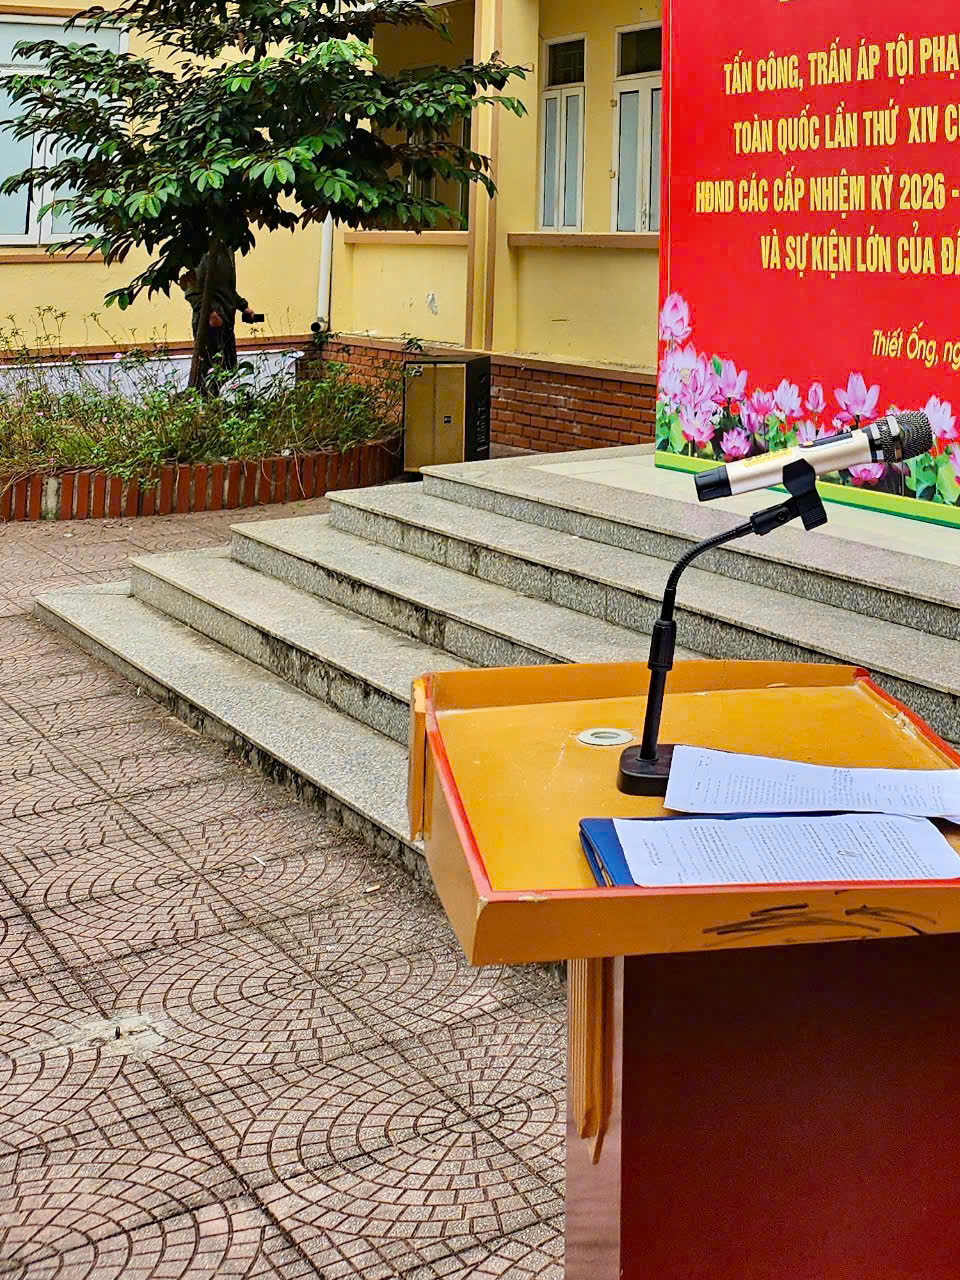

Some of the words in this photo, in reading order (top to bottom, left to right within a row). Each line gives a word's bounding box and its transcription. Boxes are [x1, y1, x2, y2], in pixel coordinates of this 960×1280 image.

[724, 50, 752, 95] TẤN
[756, 51, 803, 92] CÔNG,
[808, 36, 852, 86] TRẤN
[857, 39, 880, 81] ÁP
[886, 33, 914, 84] TỘI
[734, 114, 772, 154] TOÀN
[777, 105, 819, 155] QUỐC
[824, 102, 858, 149] LẦN
[863, 99, 899, 146] THỨ
[908, 105, 939, 144] XIV
[696, 181, 734, 212] HĐND
[739, 172, 768, 212] CÁC
[774, 166, 804, 212] CẤP
[810, 168, 865, 218] NHIỆM
[871, 166, 894, 210] KỲ
[899, 173, 945, 210] 2026
[760, 229, 780, 269] VÀ
[785, 232, 808, 278] SỰ
[812, 229, 851, 279] KIỆN
[856, 226, 891, 273] LỚN
[897, 221, 935, 275] CỦA
[872, 328, 903, 357] Thiết
[907, 322, 938, 368] Ống,
